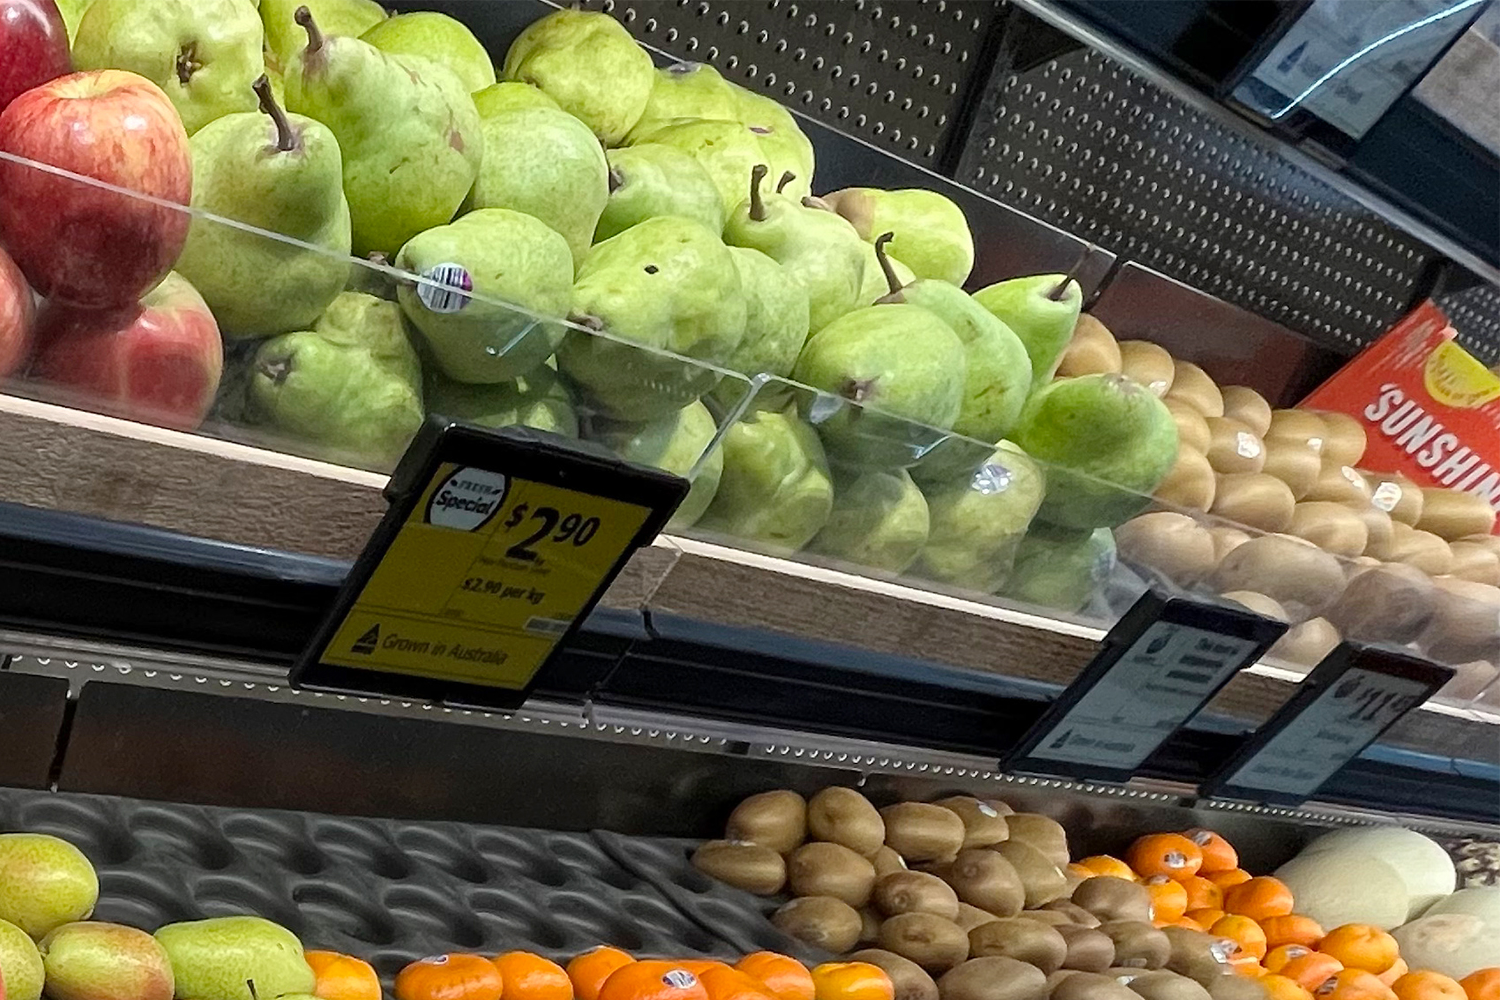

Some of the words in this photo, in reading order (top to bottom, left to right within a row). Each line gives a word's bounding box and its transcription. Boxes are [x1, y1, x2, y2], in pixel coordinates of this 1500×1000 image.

[1364, 383, 1500, 514] SUNSHIN
[436, 490, 495, 514] Special
[461, 577, 502, 593] $2.90
[499, 586, 525, 600] per
[527, 588, 546, 605] kg
[382, 633, 430, 653] Grown
[431, 642, 447, 656] in
[448, 643, 509, 665] Australia
